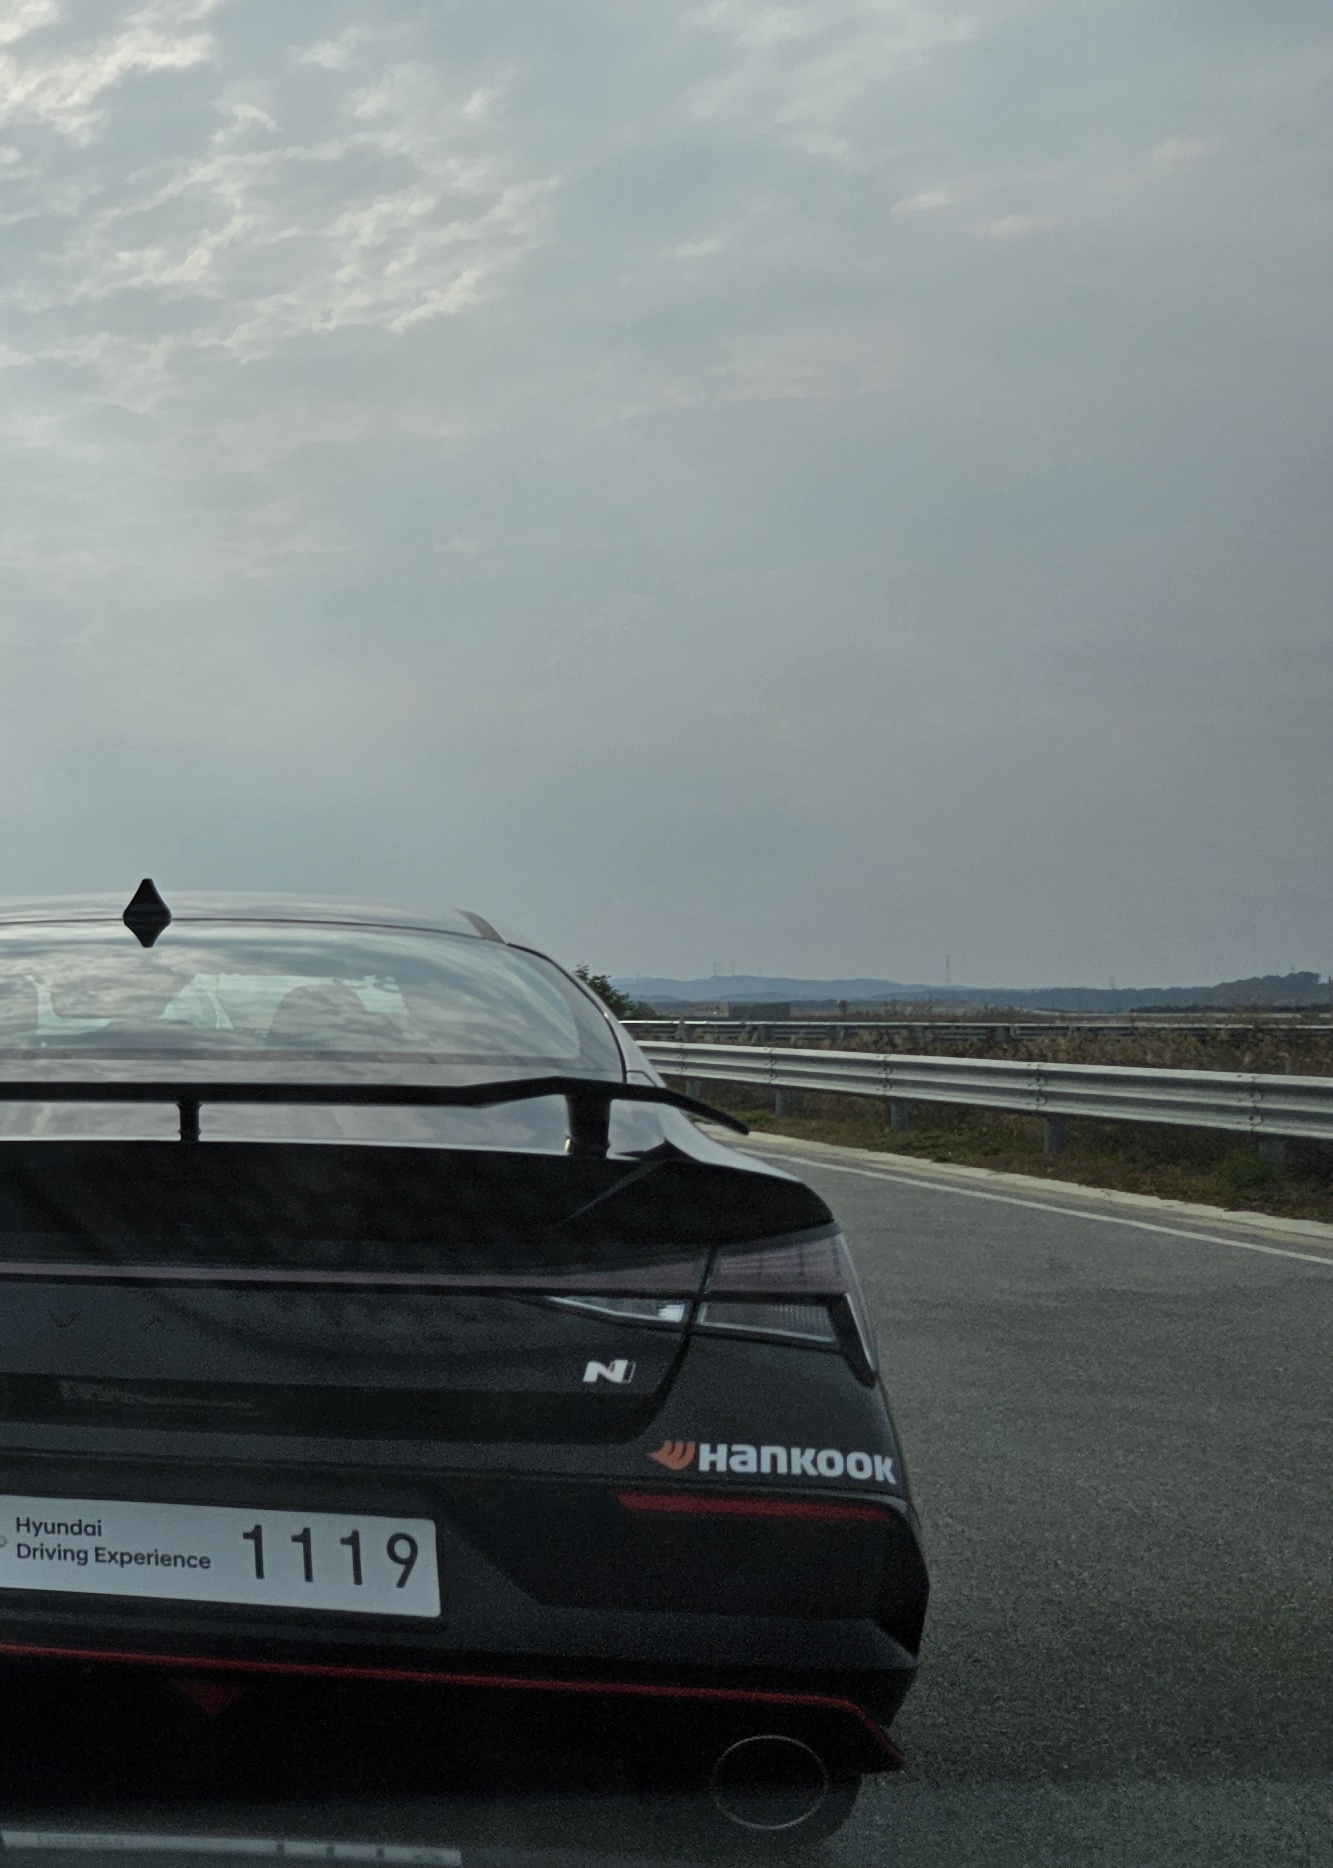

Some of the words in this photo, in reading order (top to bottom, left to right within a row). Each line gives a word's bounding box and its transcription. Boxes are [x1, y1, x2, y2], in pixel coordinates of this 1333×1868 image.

[15, 1516, 103, 1538] Hyundai
[16, 1543, 89, 1567] Driving
[94, 1547, 212, 1570] Experience
[242, 1524, 420, 1589] 1119
